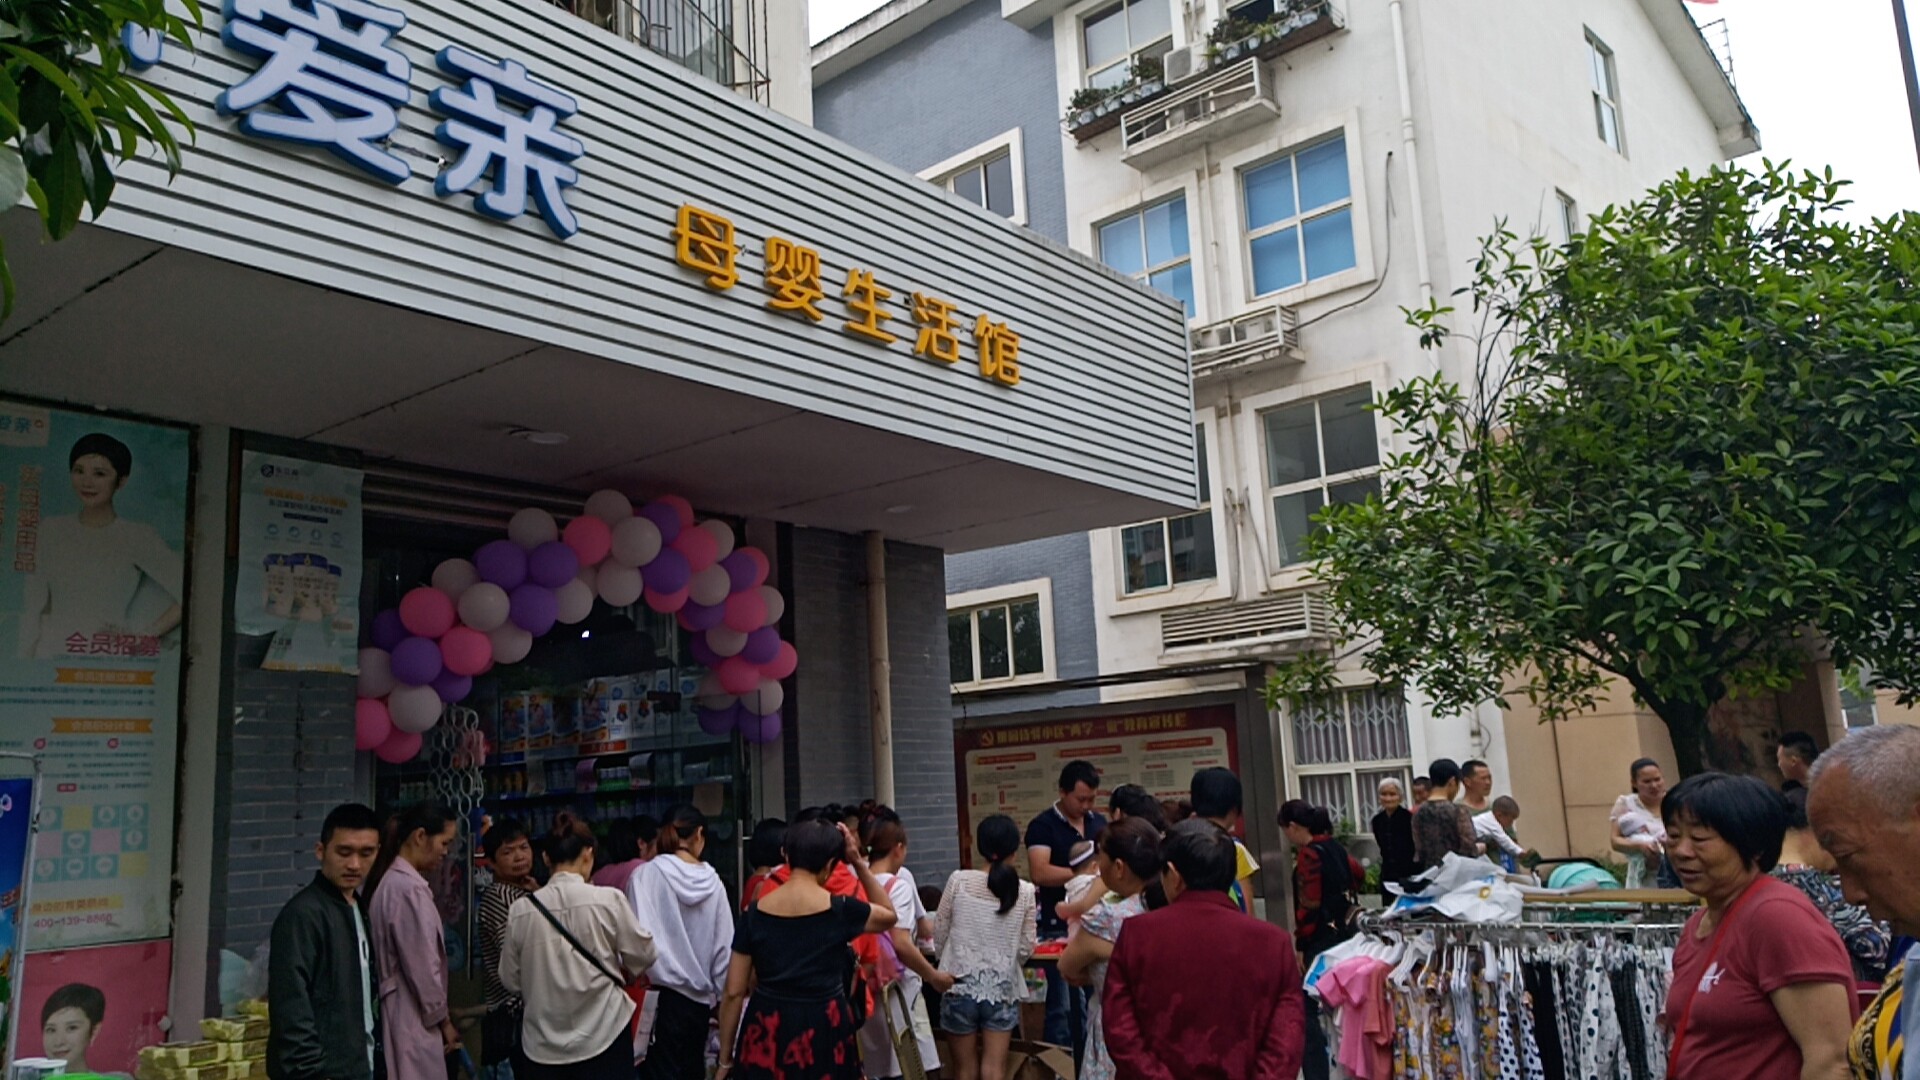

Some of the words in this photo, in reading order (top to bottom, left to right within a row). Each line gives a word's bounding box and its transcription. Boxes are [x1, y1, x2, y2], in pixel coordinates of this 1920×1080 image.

[217, 0, 585, 239] 爱亲
[672, 203, 1020, 386] 母婴生活馆
[65, 631, 161, 657] 会员招募
